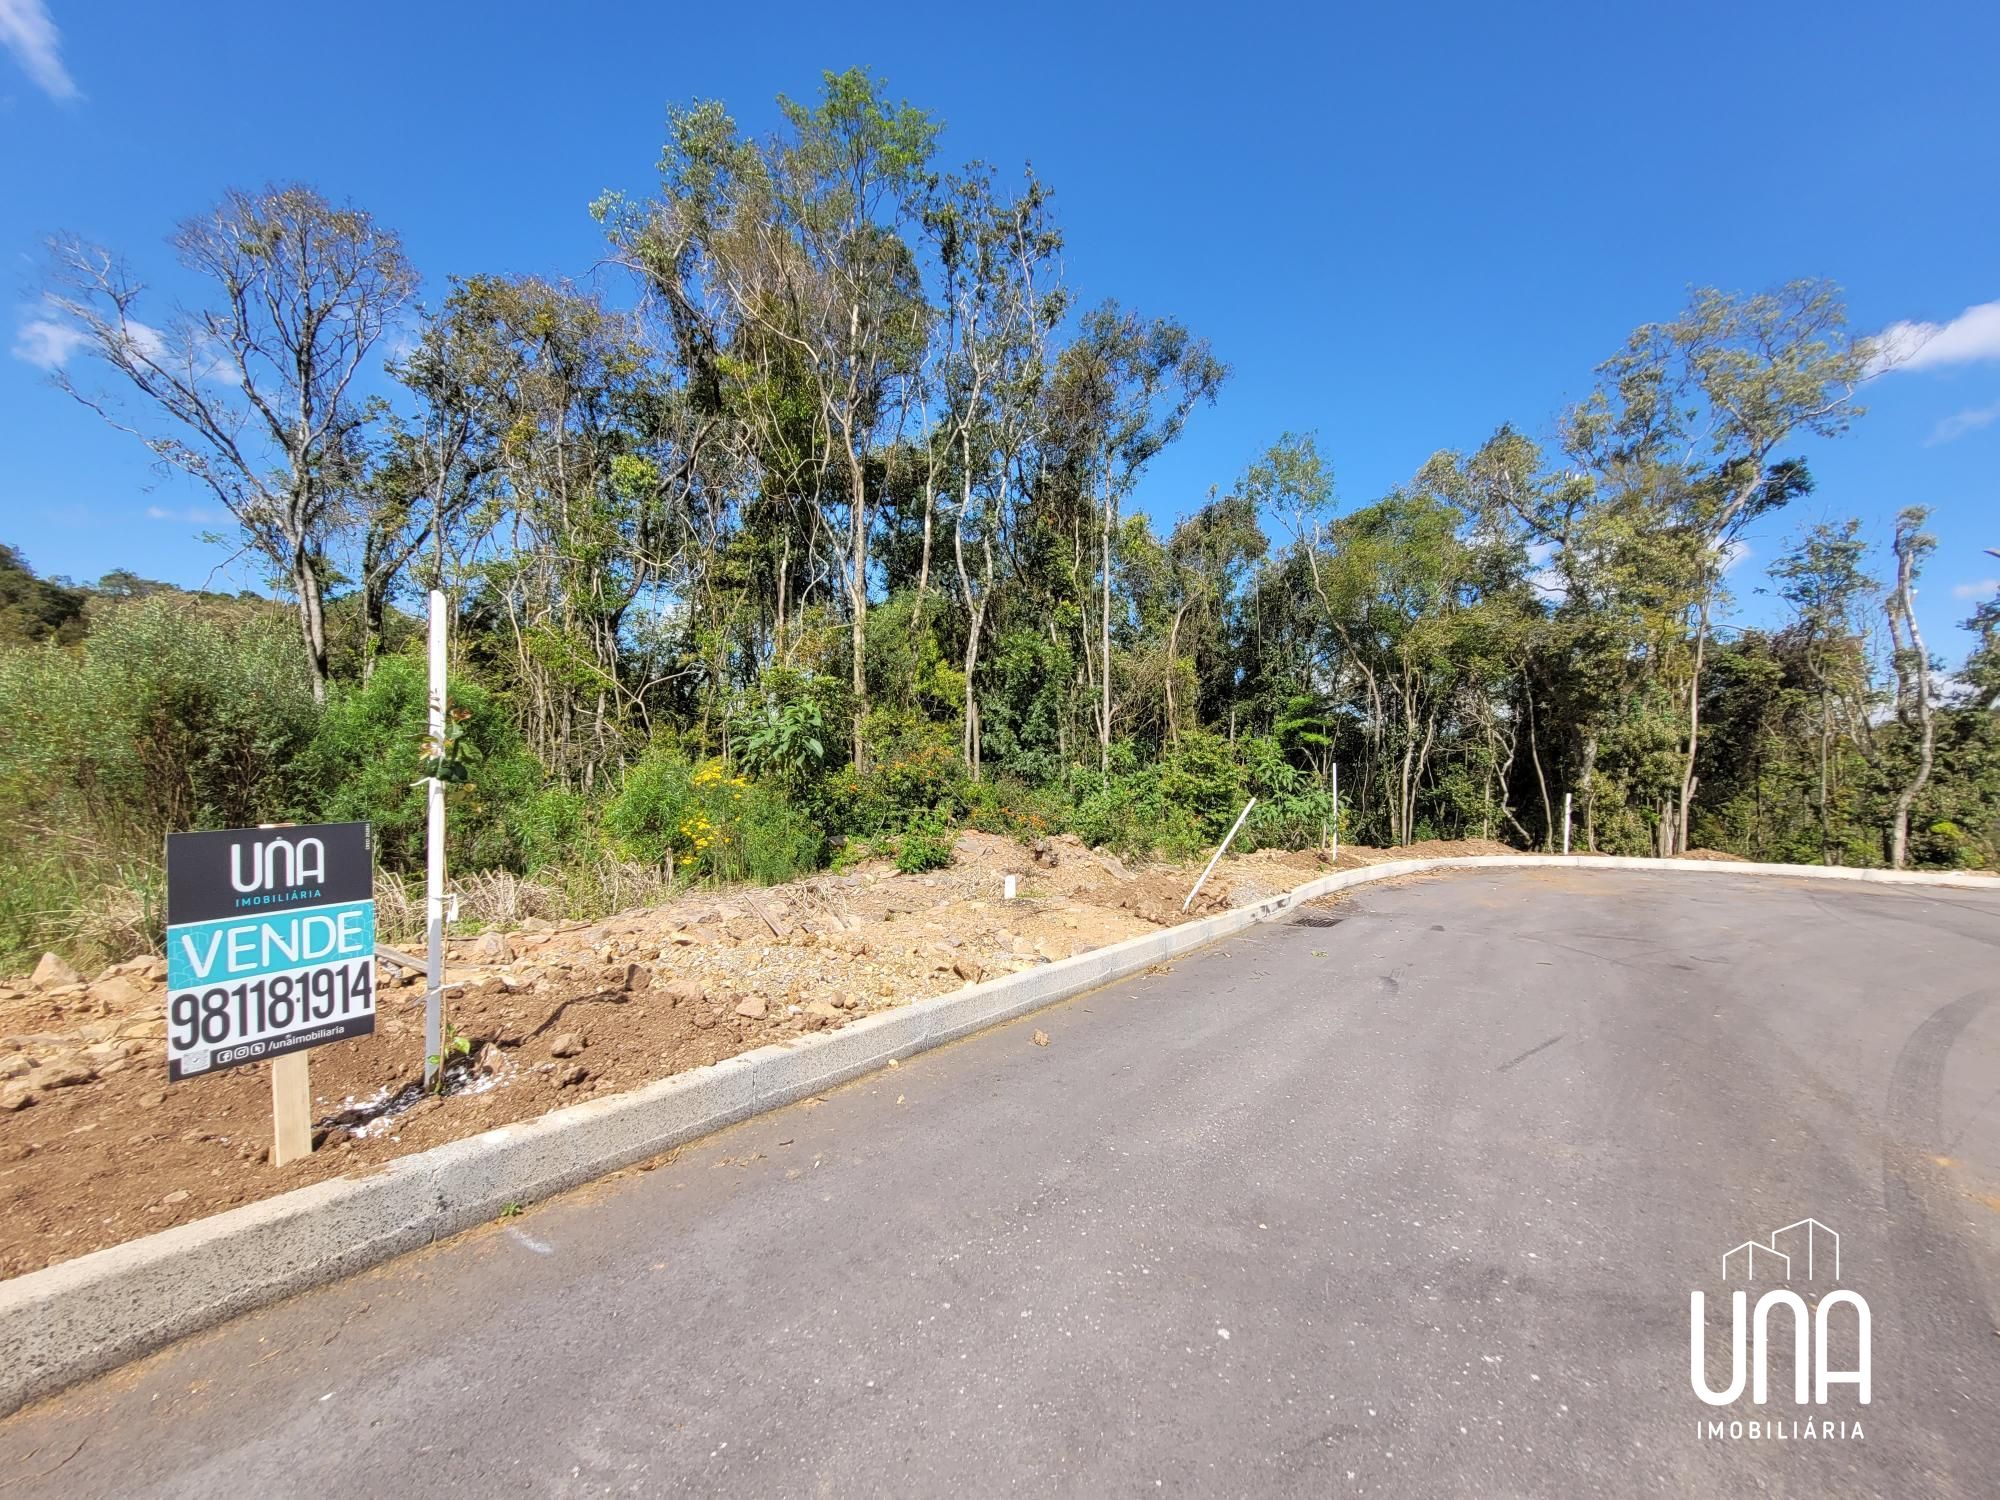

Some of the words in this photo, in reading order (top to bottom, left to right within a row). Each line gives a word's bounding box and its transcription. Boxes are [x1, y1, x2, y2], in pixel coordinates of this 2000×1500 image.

[231, 837, 325, 893] UNA
[235, 889, 321, 908] IMOBILIÁRIA
[181, 910, 364, 979] VENDE
